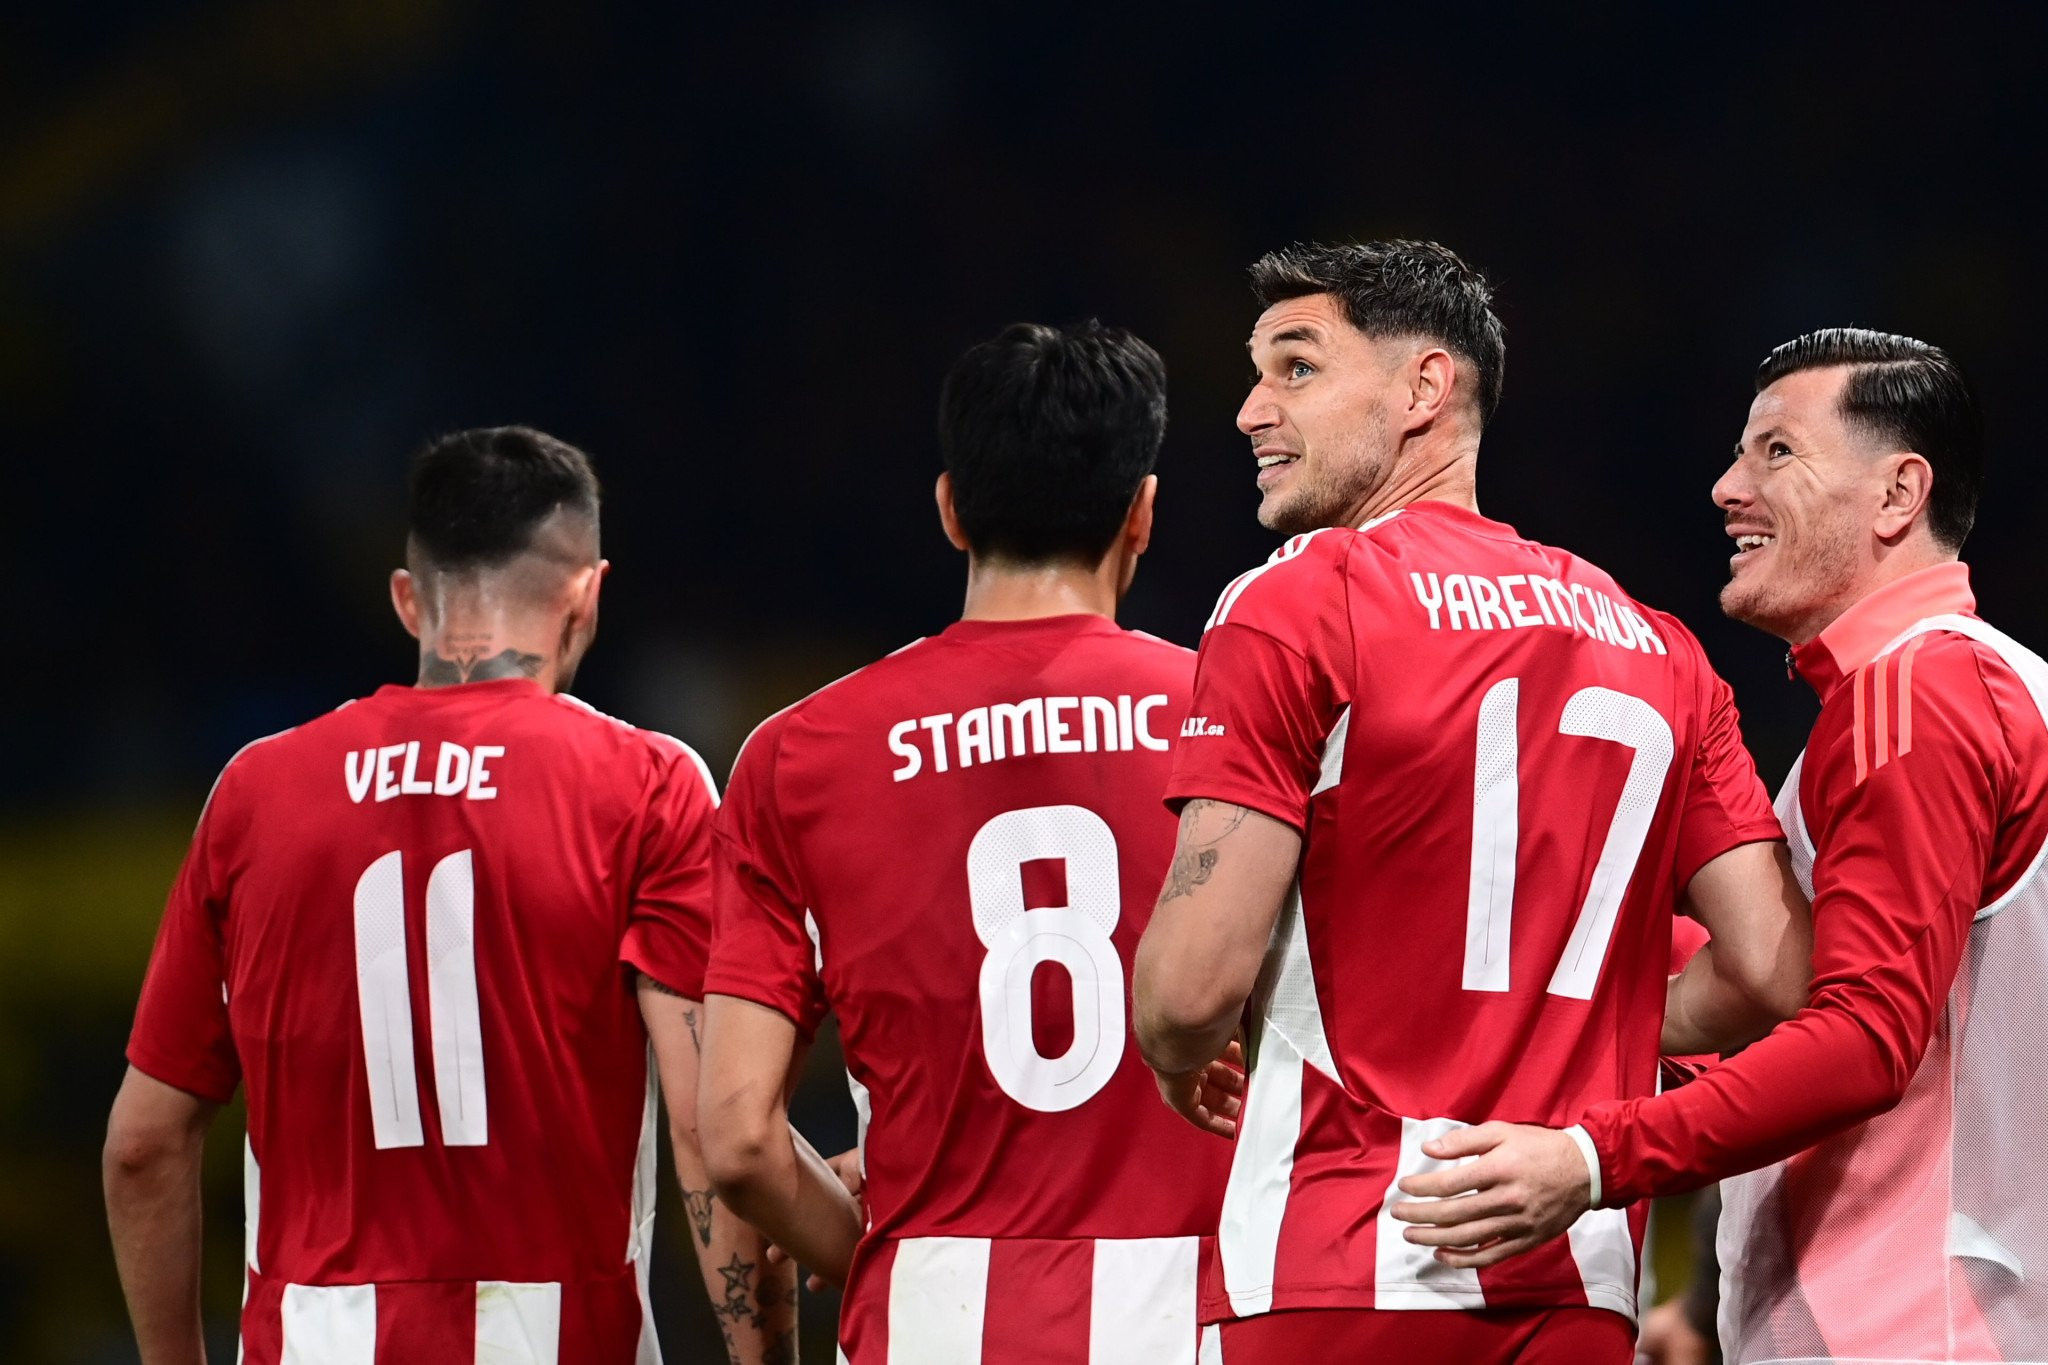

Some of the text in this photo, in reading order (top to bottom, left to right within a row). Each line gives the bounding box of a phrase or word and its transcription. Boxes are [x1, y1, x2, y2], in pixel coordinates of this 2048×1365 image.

[344, 740, 506, 804] VELDE
[887, 694, 1170, 783] STAMENIC
[1461, 677, 1675, 1002] 17
[353, 848, 488, 1150] 11
[966, 804, 1126, 1113] 8
